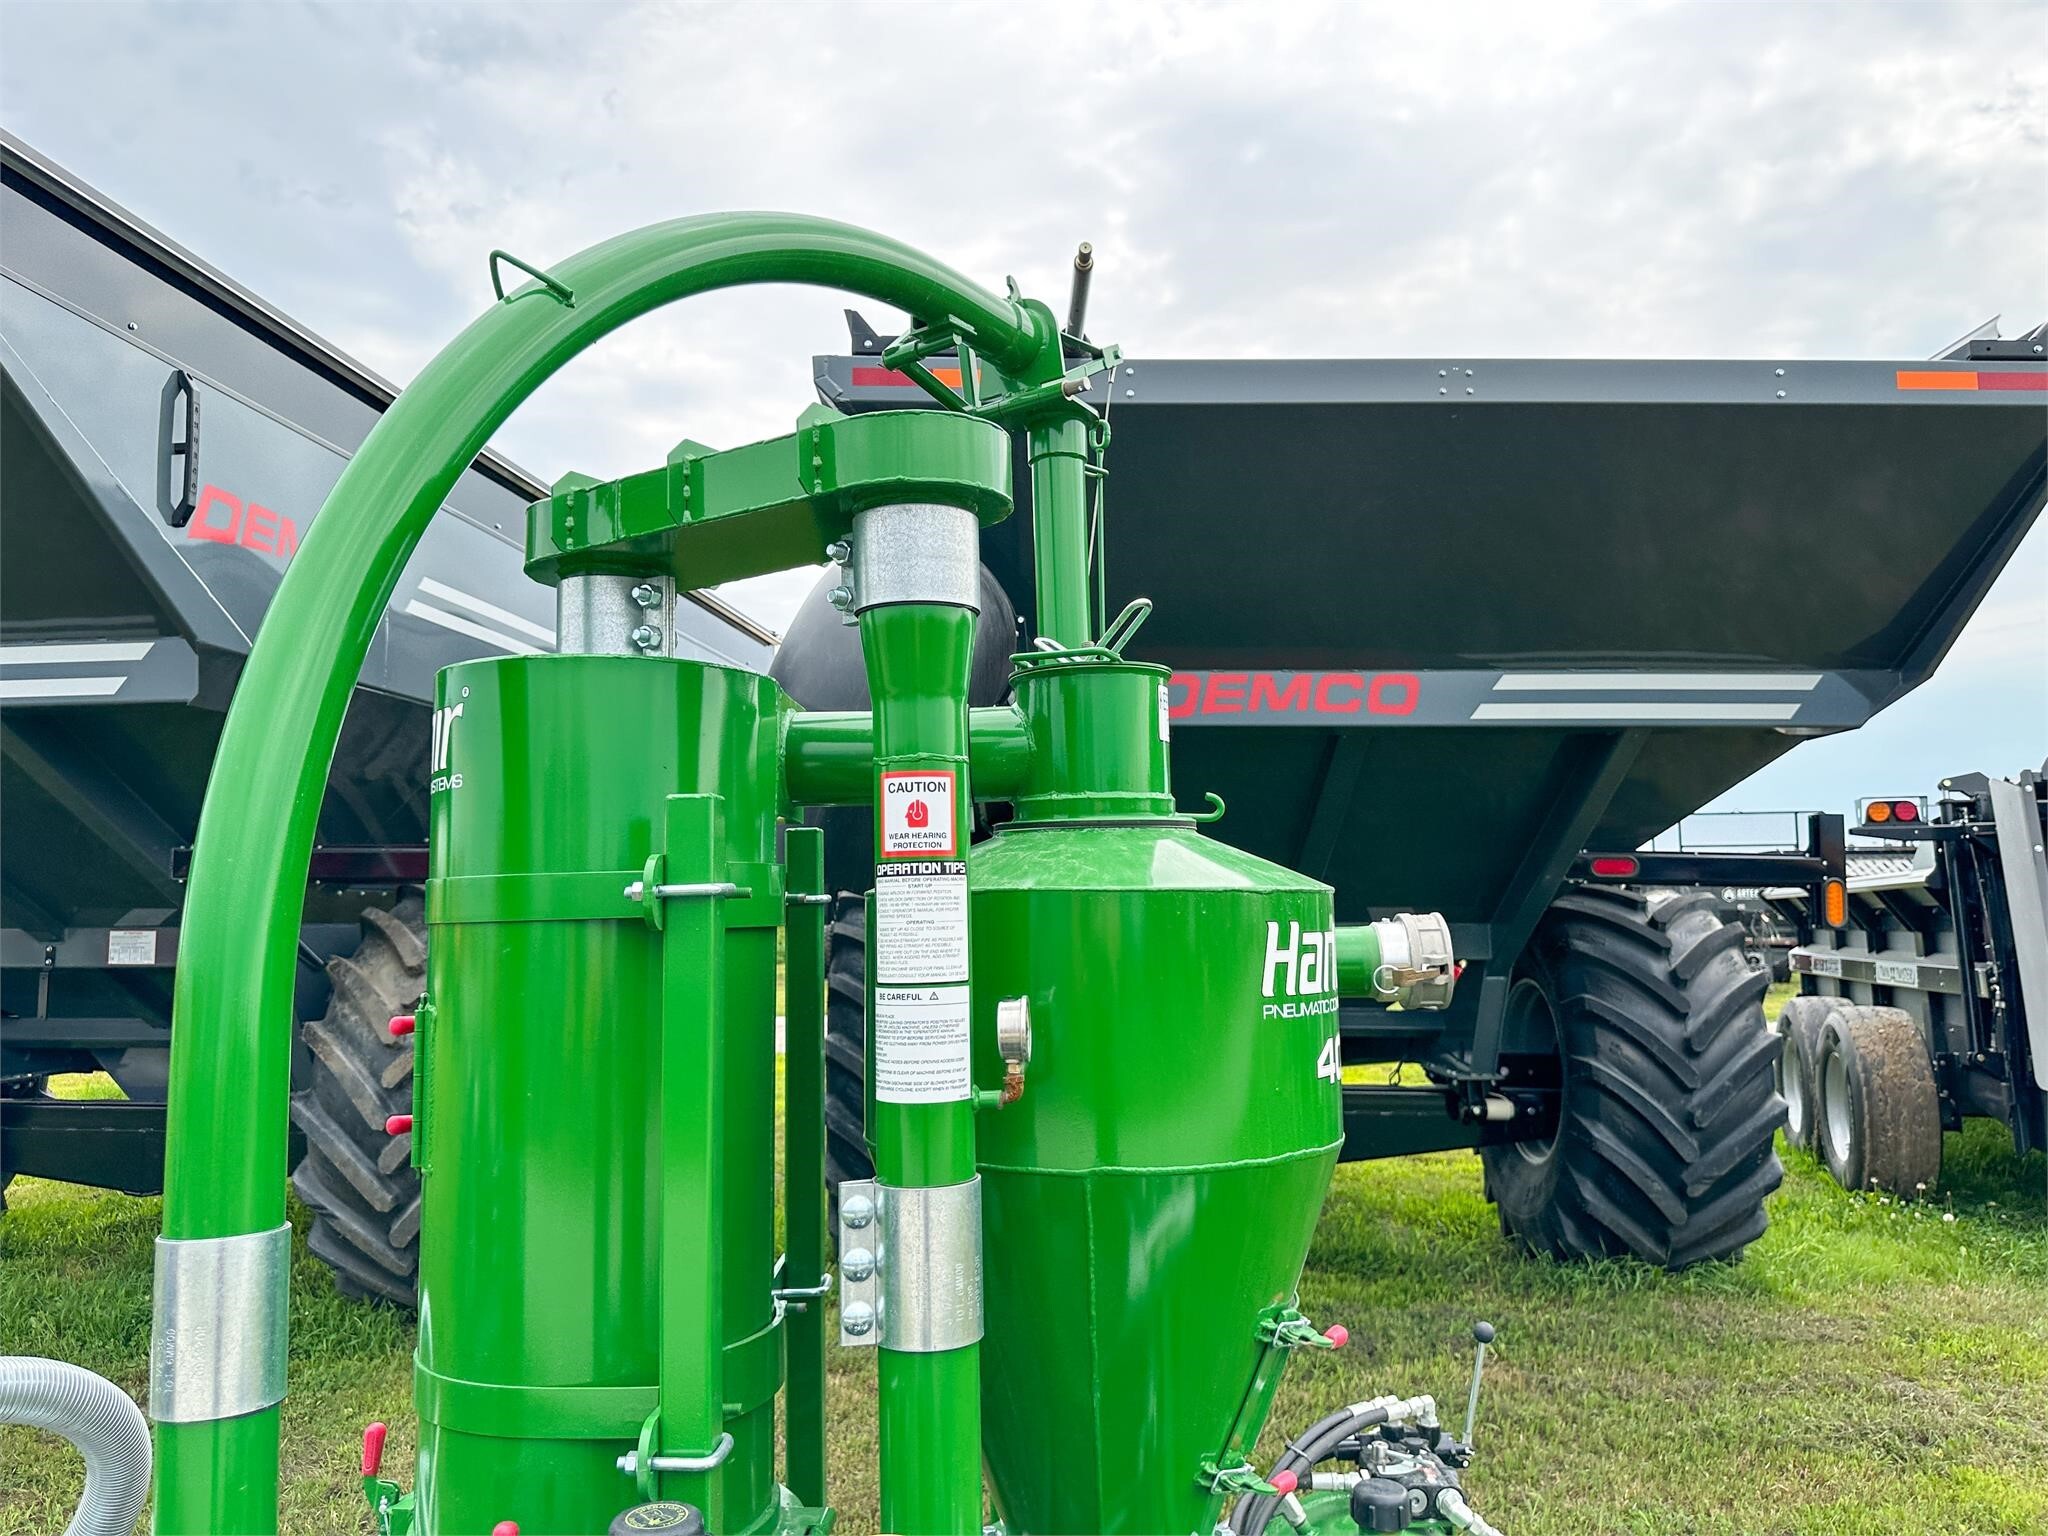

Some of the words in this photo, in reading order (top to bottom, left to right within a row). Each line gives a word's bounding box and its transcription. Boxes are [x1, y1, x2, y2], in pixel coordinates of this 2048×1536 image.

[888, 781, 946, 793] CAUTION
[889, 832, 910, 840] WEAR
[877, 862, 941, 875] OPERATION
[943, 862, 966, 874] TIPS
[1263, 1000, 1329, 1020] PNEUMATIC
